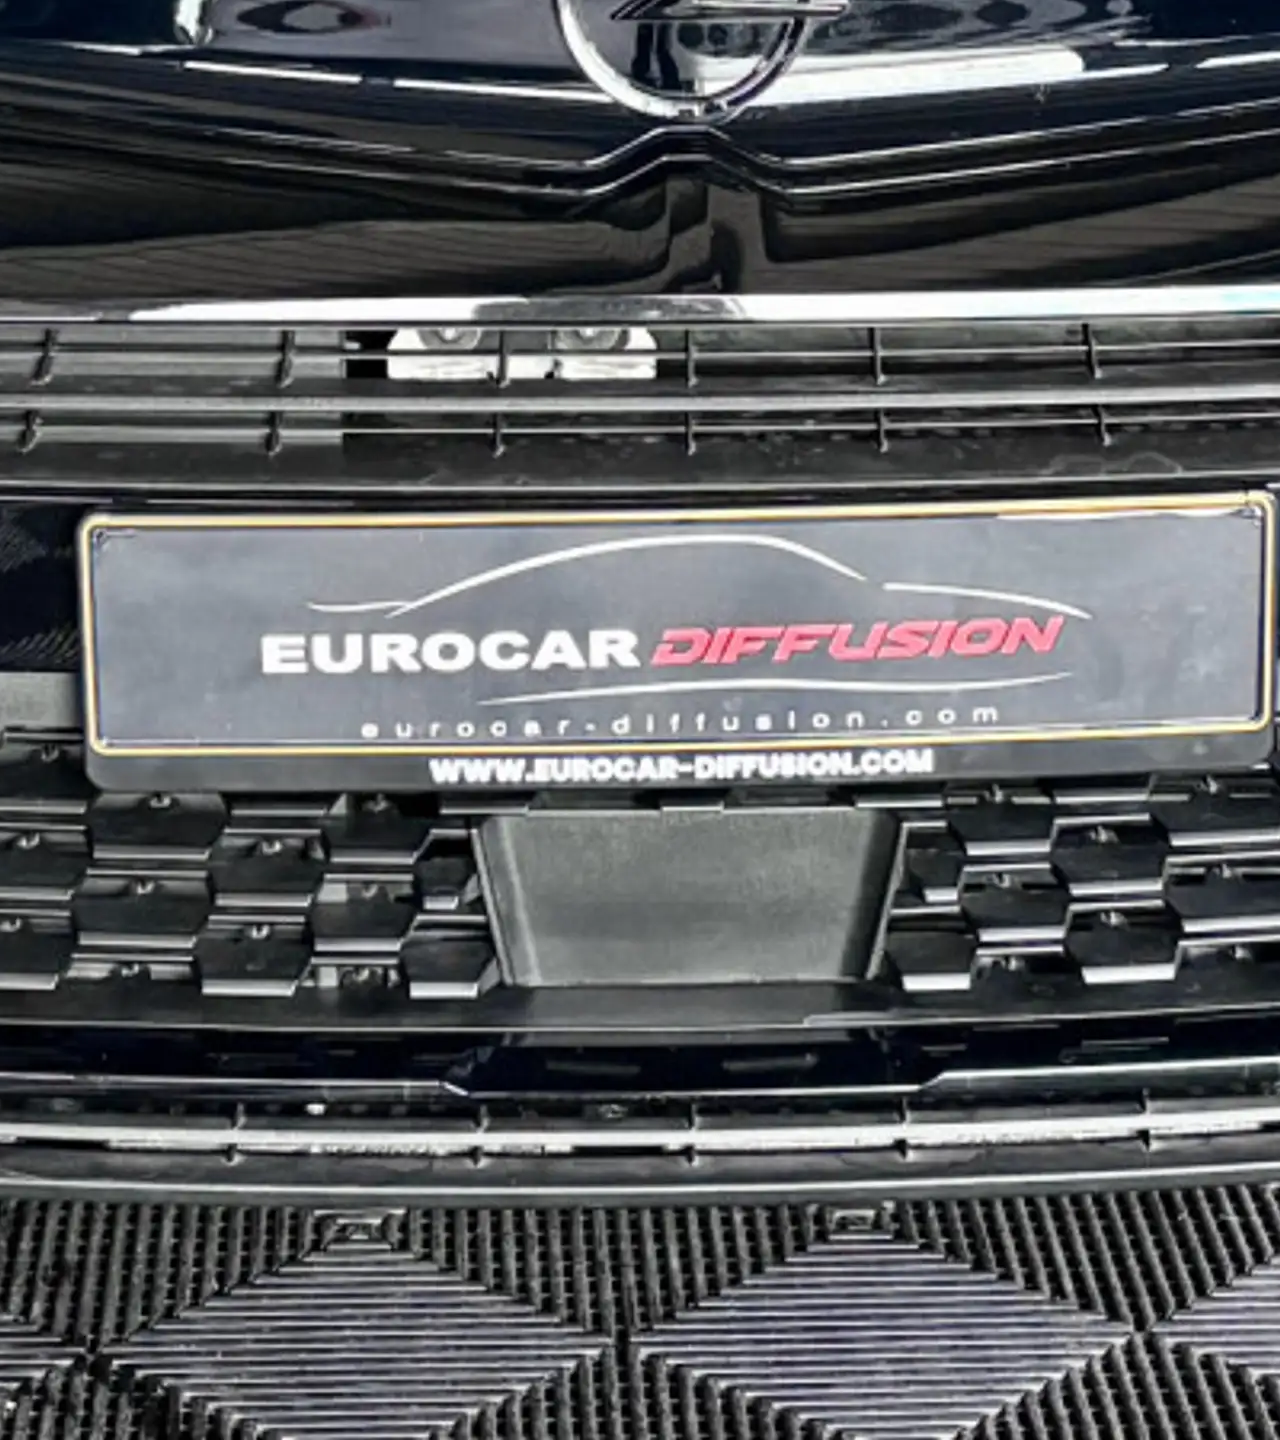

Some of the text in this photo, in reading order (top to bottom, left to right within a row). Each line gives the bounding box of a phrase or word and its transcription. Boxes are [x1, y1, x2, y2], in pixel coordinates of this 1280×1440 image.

[260, 614, 1064, 675] EUROCAR DIFFUSION
[428, 747, 936, 784] WWW.EUROCAR-DIFFUSION.COM
